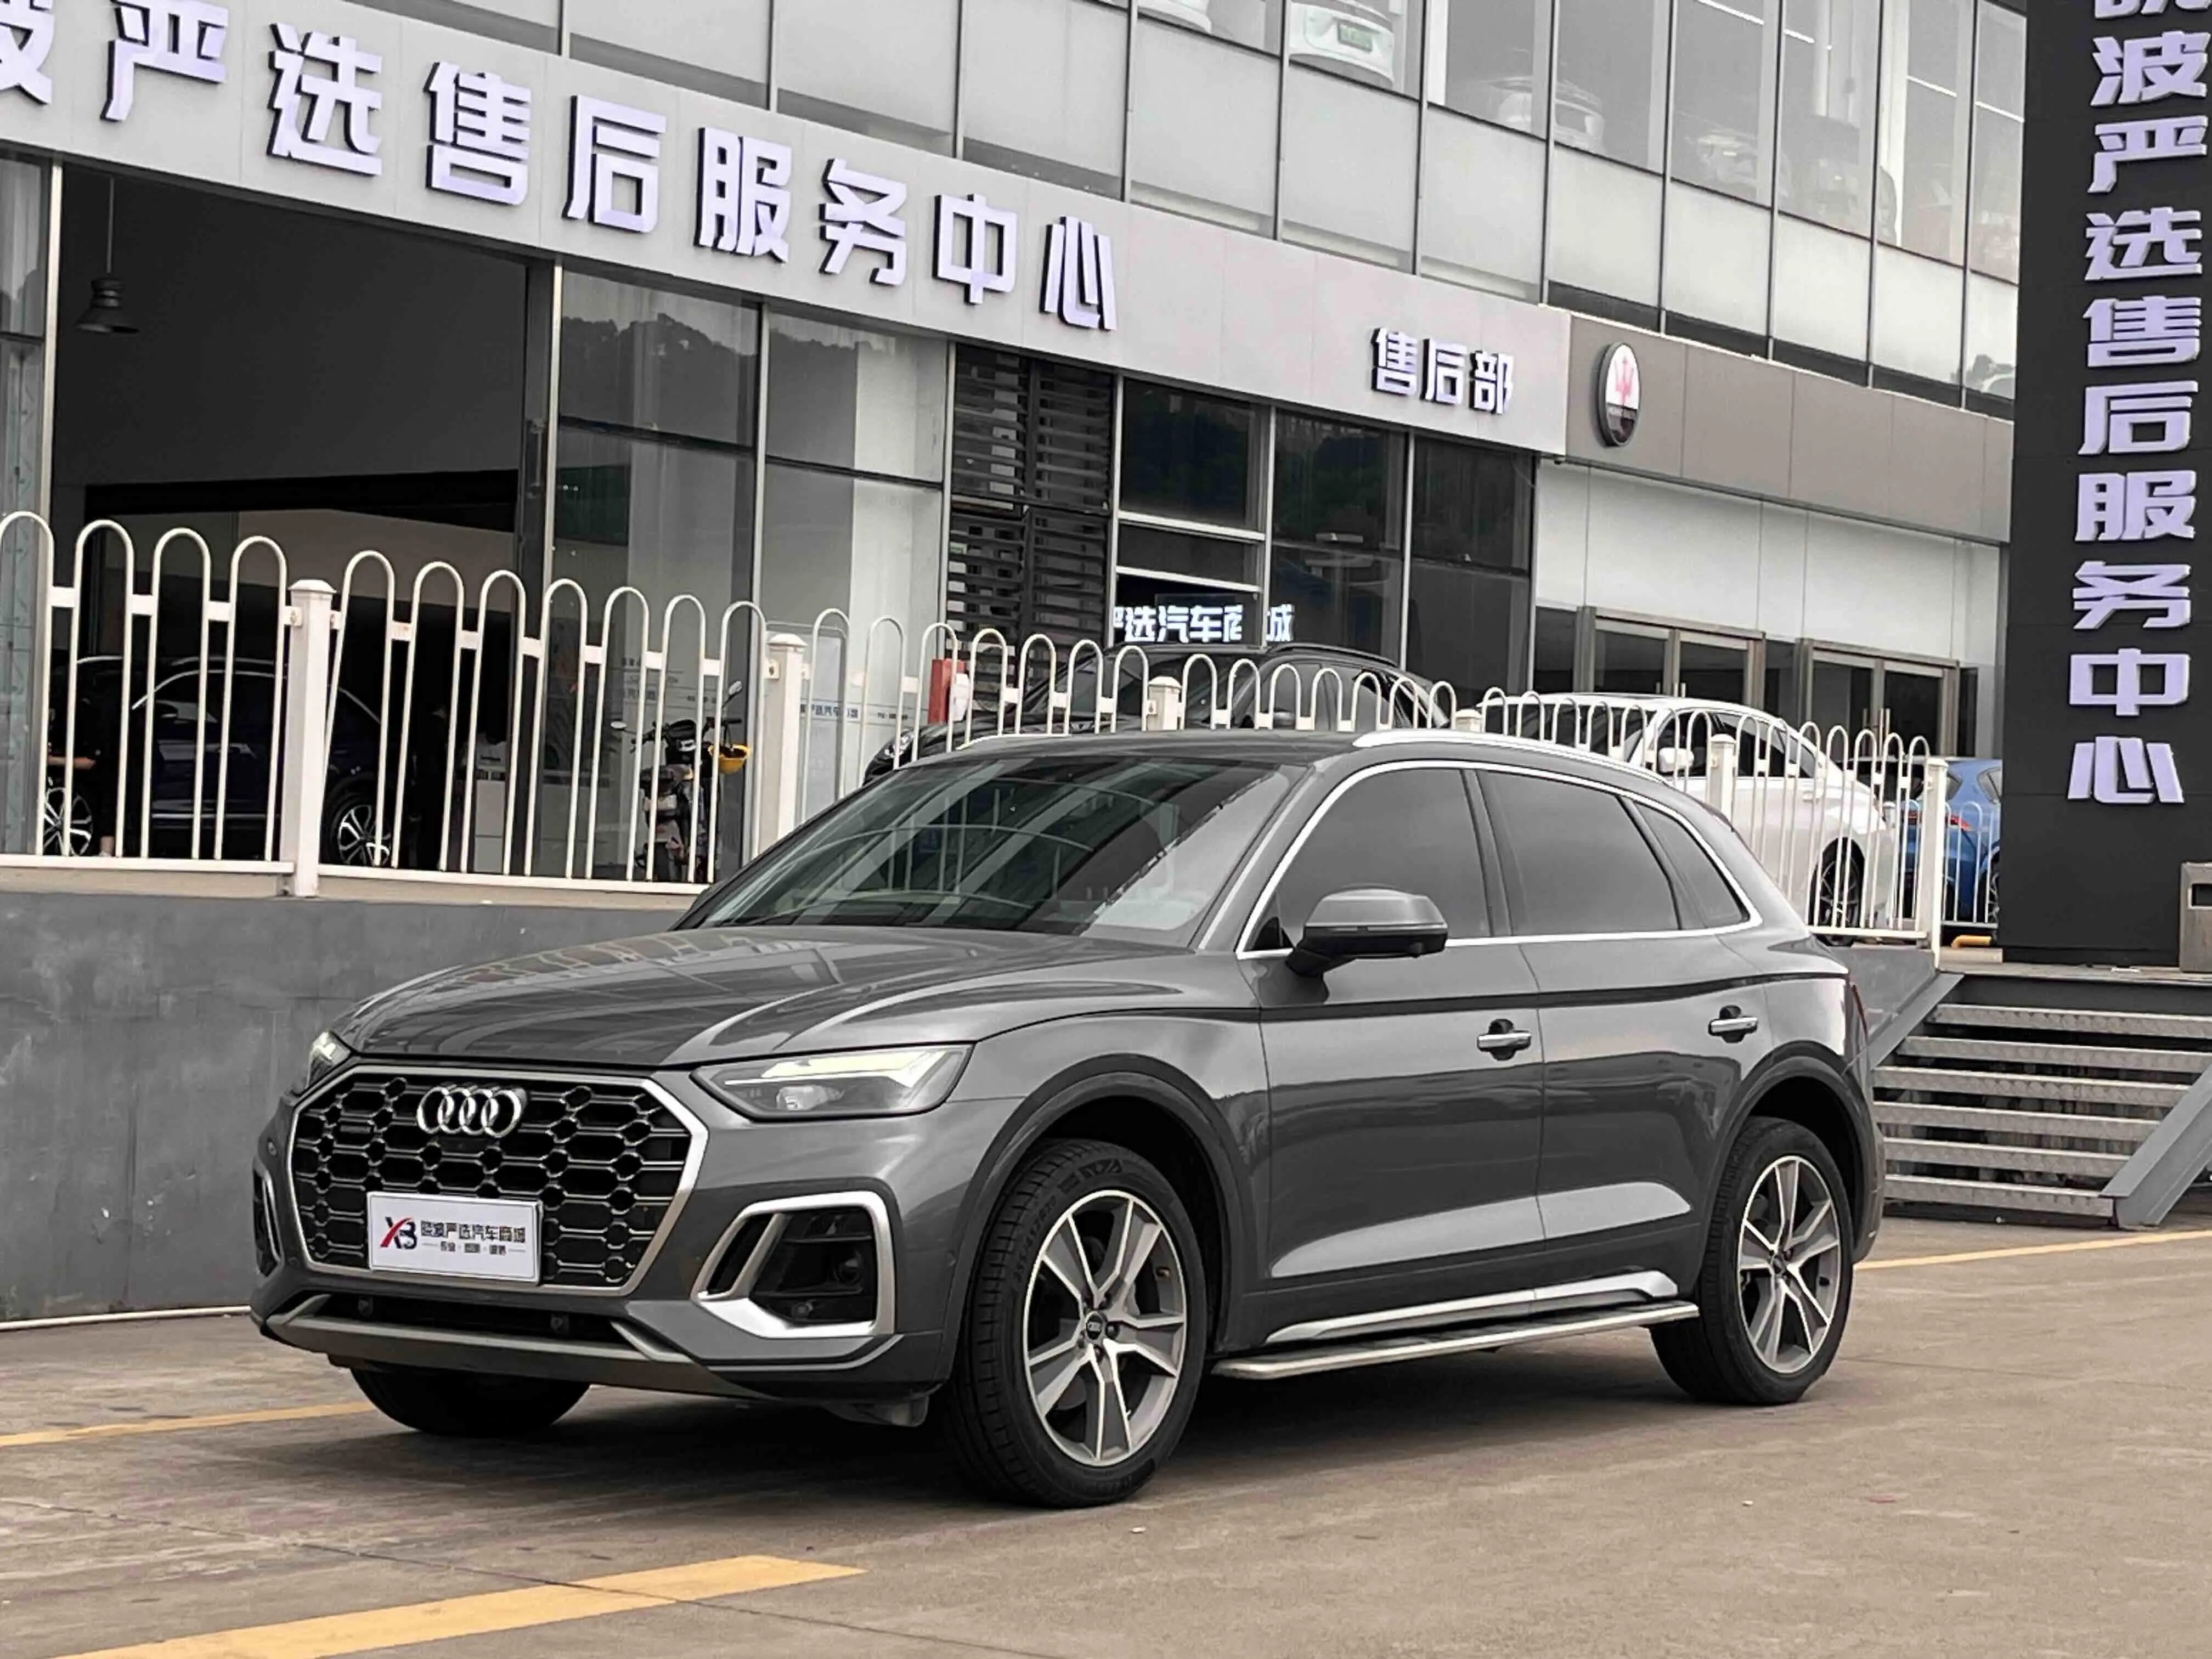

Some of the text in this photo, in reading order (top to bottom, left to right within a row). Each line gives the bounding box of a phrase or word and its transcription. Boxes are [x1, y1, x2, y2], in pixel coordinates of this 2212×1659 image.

[1372, 327, 1514, 415] 售后部
[2067, 0, 2211, 804] 波严选售后服务中心
